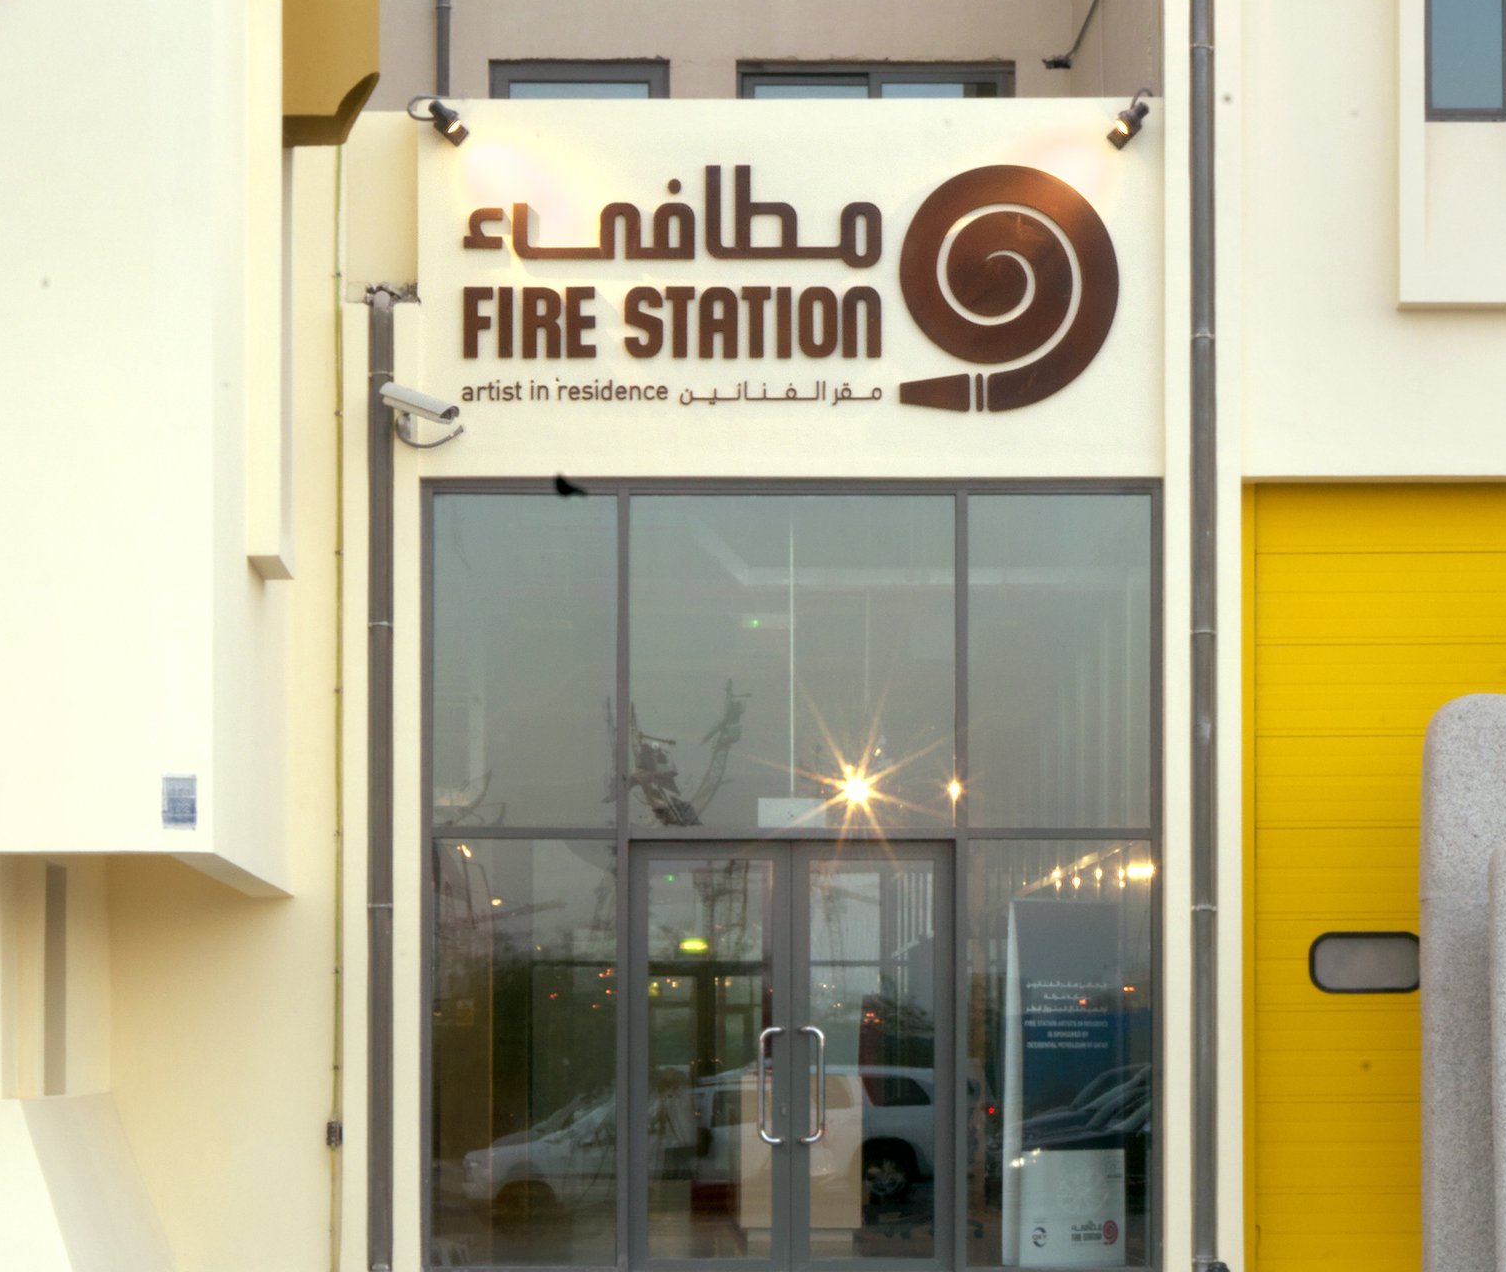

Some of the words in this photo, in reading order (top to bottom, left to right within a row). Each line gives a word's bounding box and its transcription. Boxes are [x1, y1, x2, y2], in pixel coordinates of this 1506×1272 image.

[463, 286, 597, 359] FIRE
[624, 286, 883, 359] STATION
[461, 380, 522, 402] artist
[529, 380, 549, 402] in
[557, 379, 669, 402] residence
[679, 380, 827, 406] الفنانين
[832, 381, 883, 406] مقر
